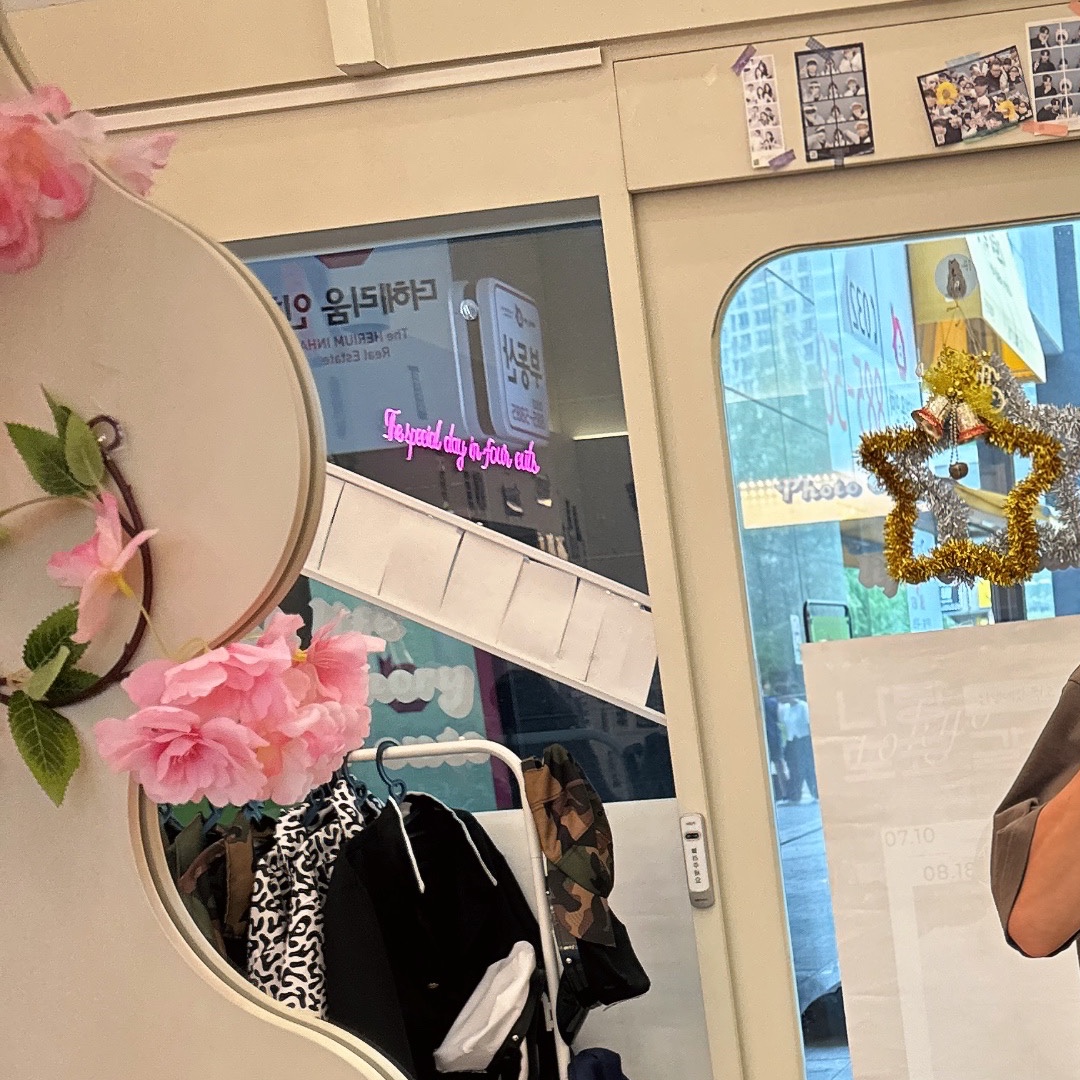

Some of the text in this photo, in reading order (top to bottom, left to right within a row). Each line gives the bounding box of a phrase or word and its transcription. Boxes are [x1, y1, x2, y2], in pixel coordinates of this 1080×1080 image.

[404, 419, 443, 461] special
[443, 423, 468, 472] day
[884, 827, 935, 848] 07.10
